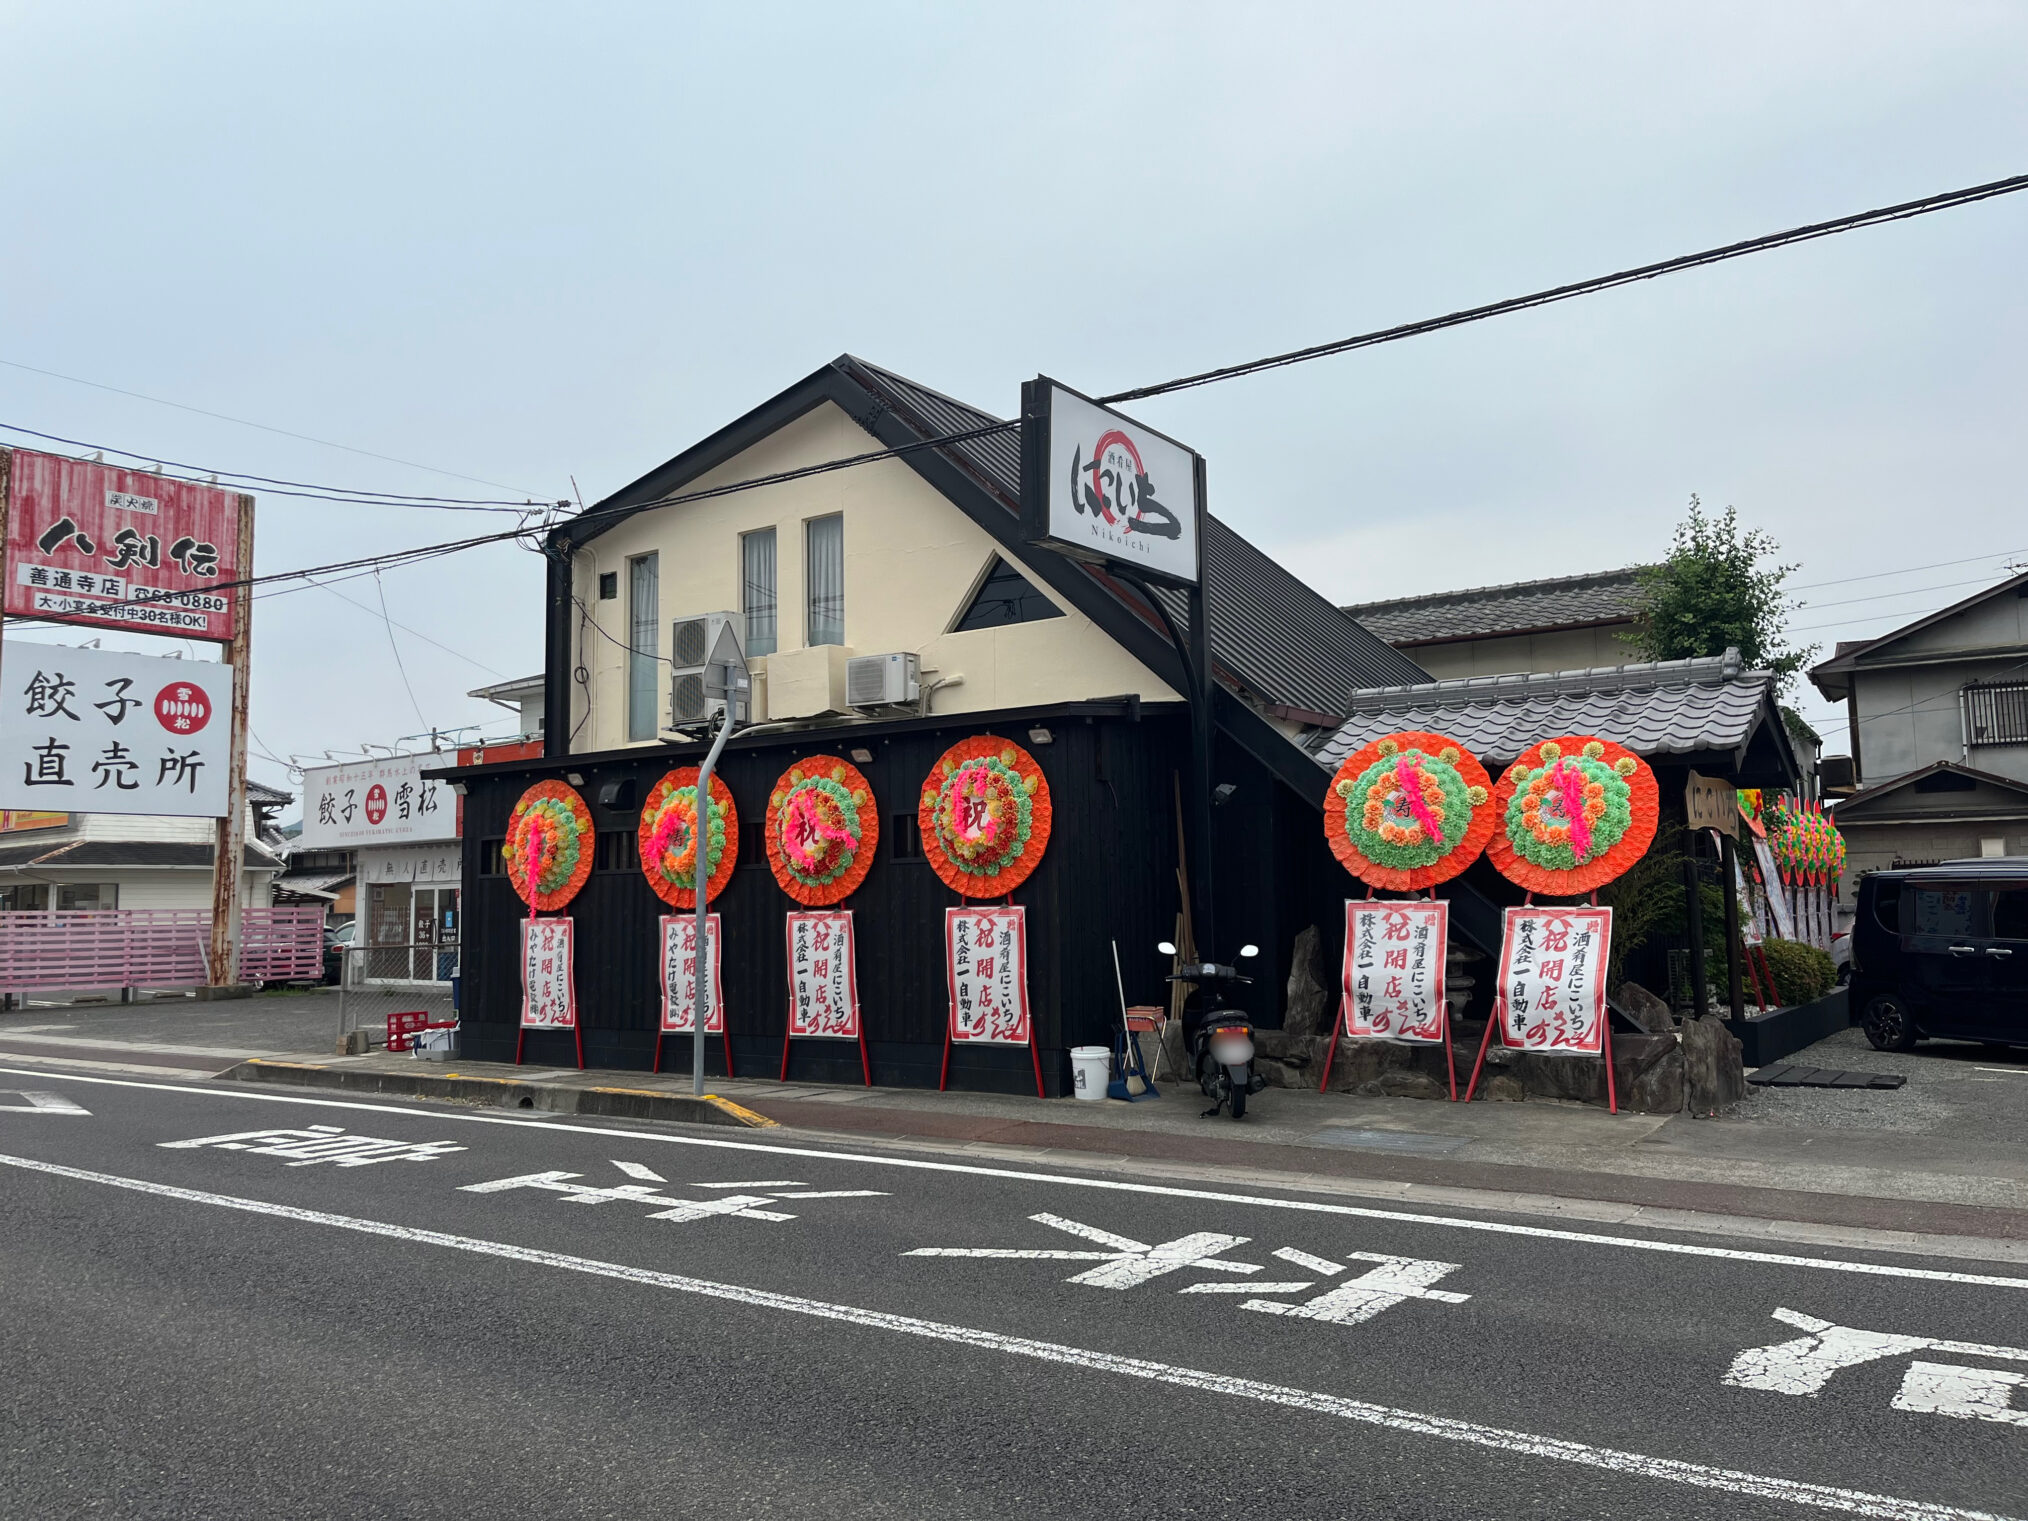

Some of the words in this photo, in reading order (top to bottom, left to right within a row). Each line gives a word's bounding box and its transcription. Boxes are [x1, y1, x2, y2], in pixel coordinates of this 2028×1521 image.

[38, 516, 219, 577] 八剣伝
[1091, 523, 1150, 554] Nikoichi
[29, 566, 120, 597] 善通寺店
[24, 670, 144, 726] 餃子
[173, 716, 191, 730] 松
[176, 687, 193, 702] 雪
[24, 736, 206, 795] 直売所
[318, 788, 358, 826] 餃子
[394, 781, 438, 821] 雪松
[962, 796, 988, 833] 祝
[540, 934, 555, 998] 祝開店
[680, 932, 697, 1001] 祝開店
[811, 930, 830, 1004] 祝開店
[832, 933, 845, 1020] 酒肴屋にこいち
[974, 926, 995, 1008] 祝開店
[998, 930, 1014, 1023] 酒肴屋にこいち
[1381, 921, 1411, 999] 祝開店
[1411, 925, 1429, 1023] 酒肴屋にこいち
[1535, 928, 1569, 1012] 祝開店
[1567, 930, 1592, 1031] 酒肴屋にこいち
